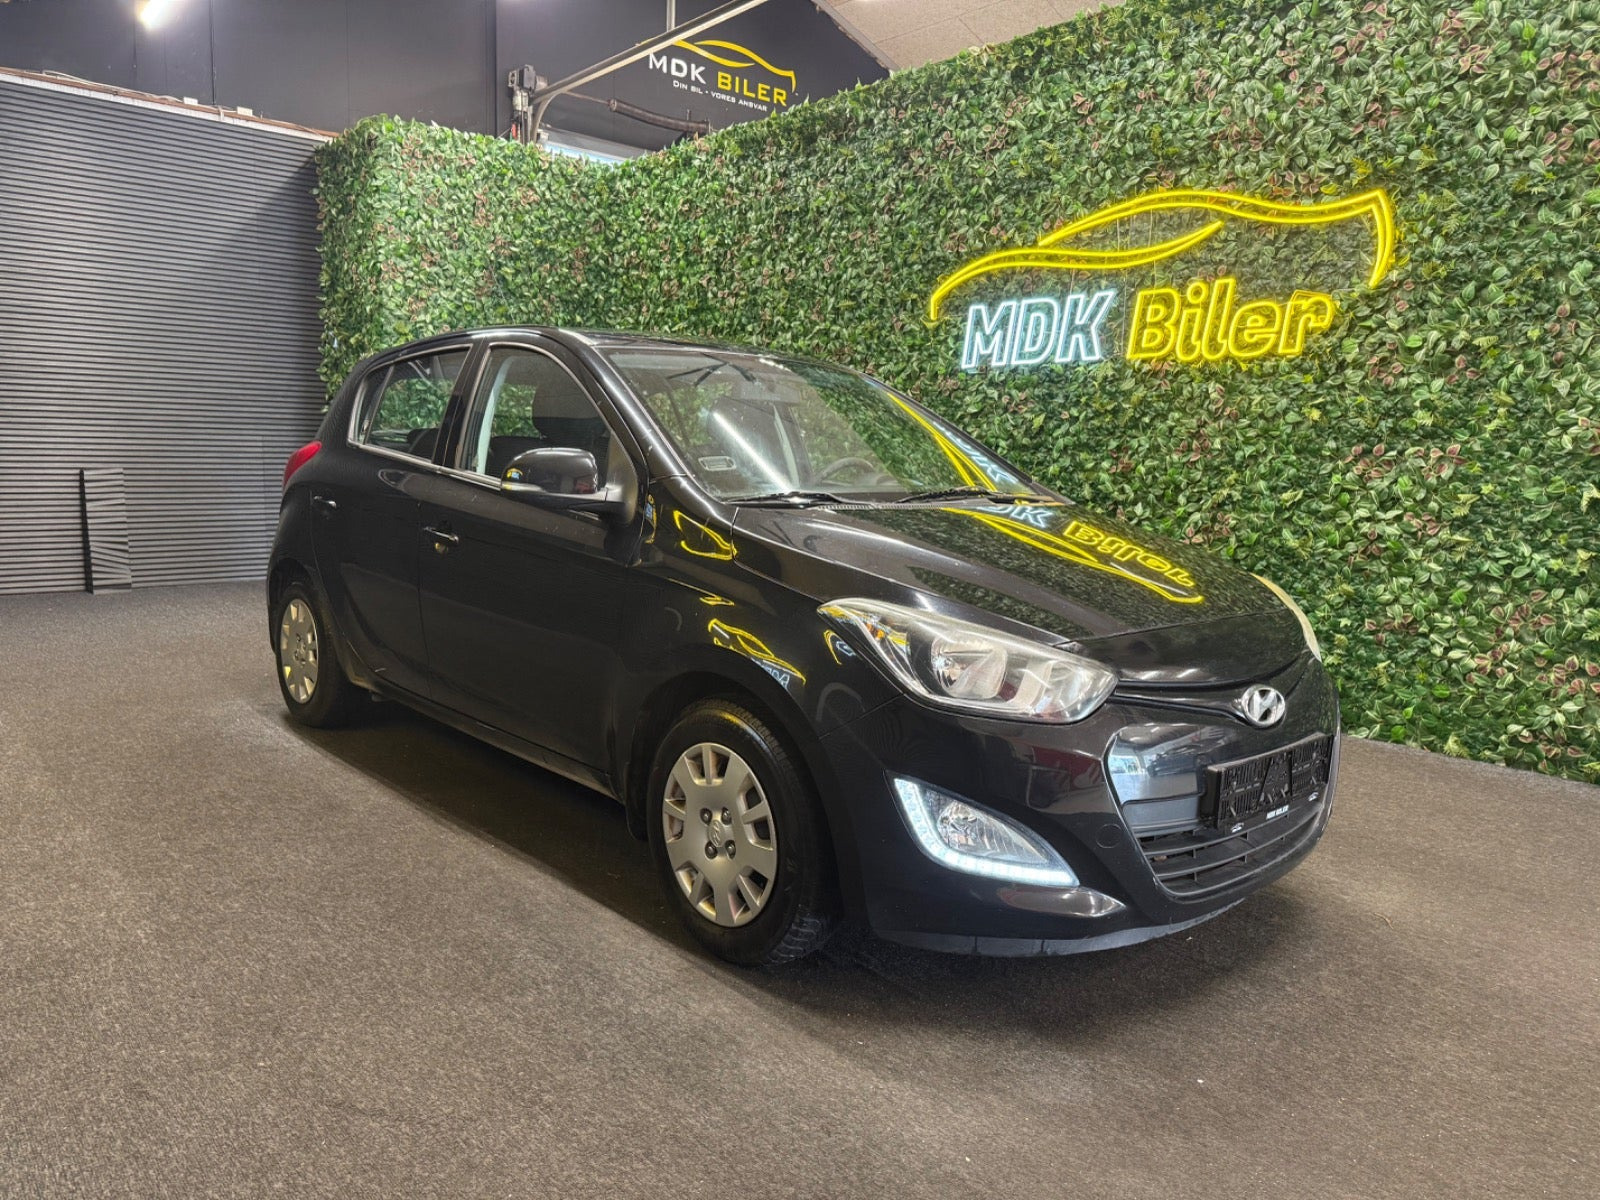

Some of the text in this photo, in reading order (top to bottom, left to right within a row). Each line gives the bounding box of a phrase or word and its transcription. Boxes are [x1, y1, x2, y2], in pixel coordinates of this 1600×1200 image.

[648, 51, 787, 107] MDK BILER
[690, 85, 703, 95] BIL
[711, 91, 736, 104] VORES
[738, 99, 768, 112] ANSVAR
[961, 277, 1336, 371] MDK Biler
